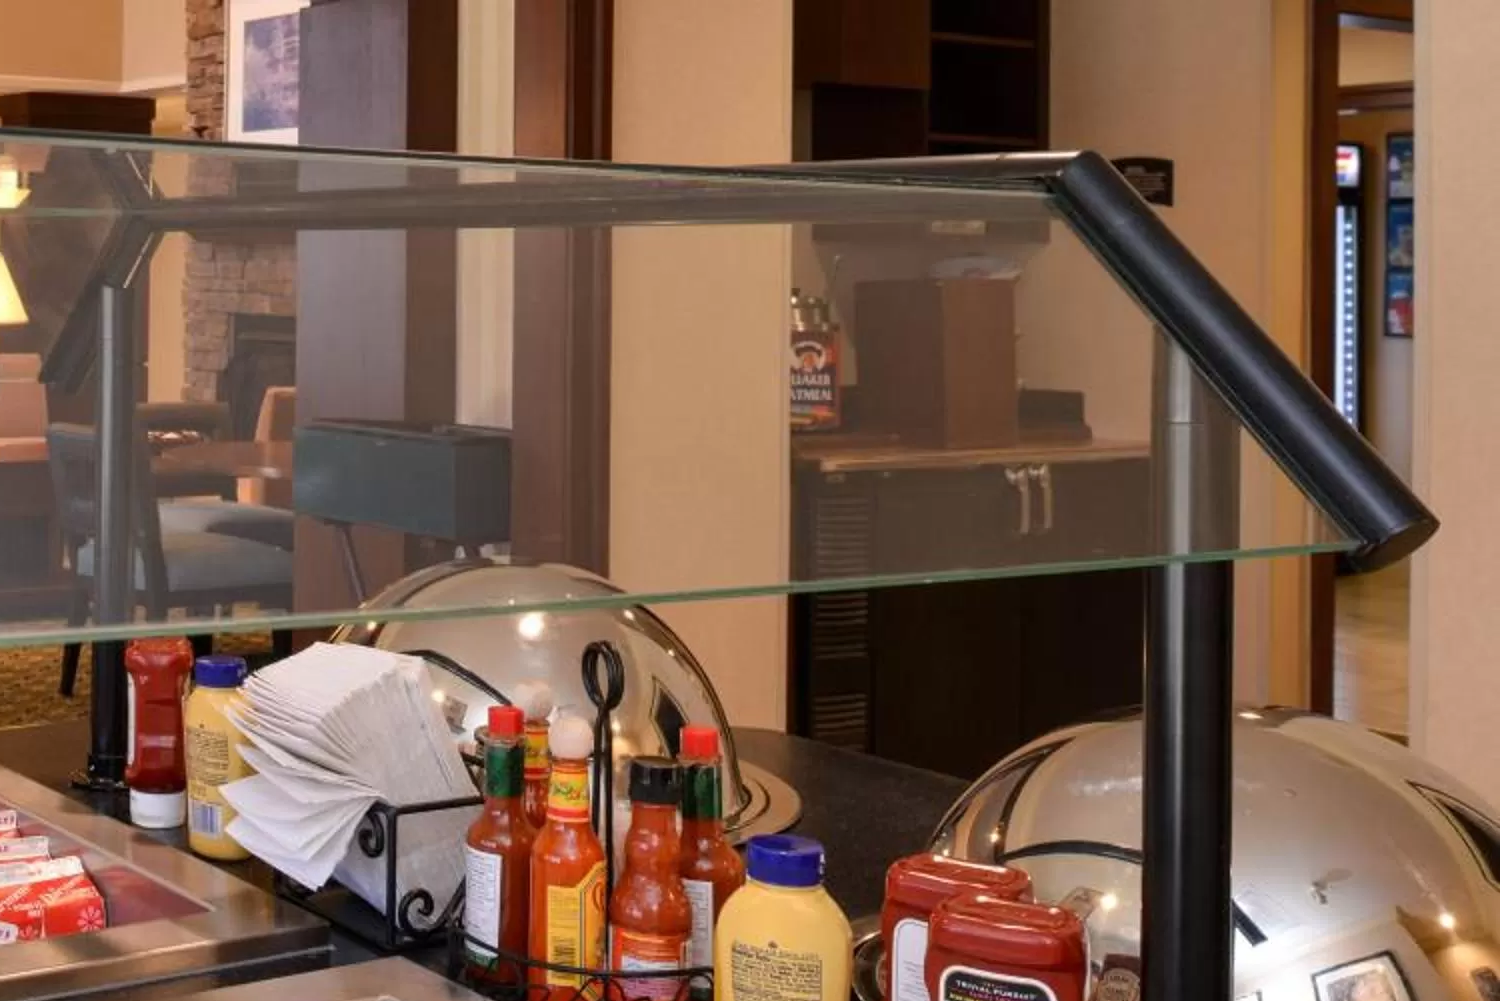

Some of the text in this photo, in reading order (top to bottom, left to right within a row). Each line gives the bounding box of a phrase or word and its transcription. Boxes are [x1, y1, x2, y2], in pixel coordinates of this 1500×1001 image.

[791, 374, 831, 385] UAKER
[955, 979, 1038, 1001] TRIVIAL PURSUIT
